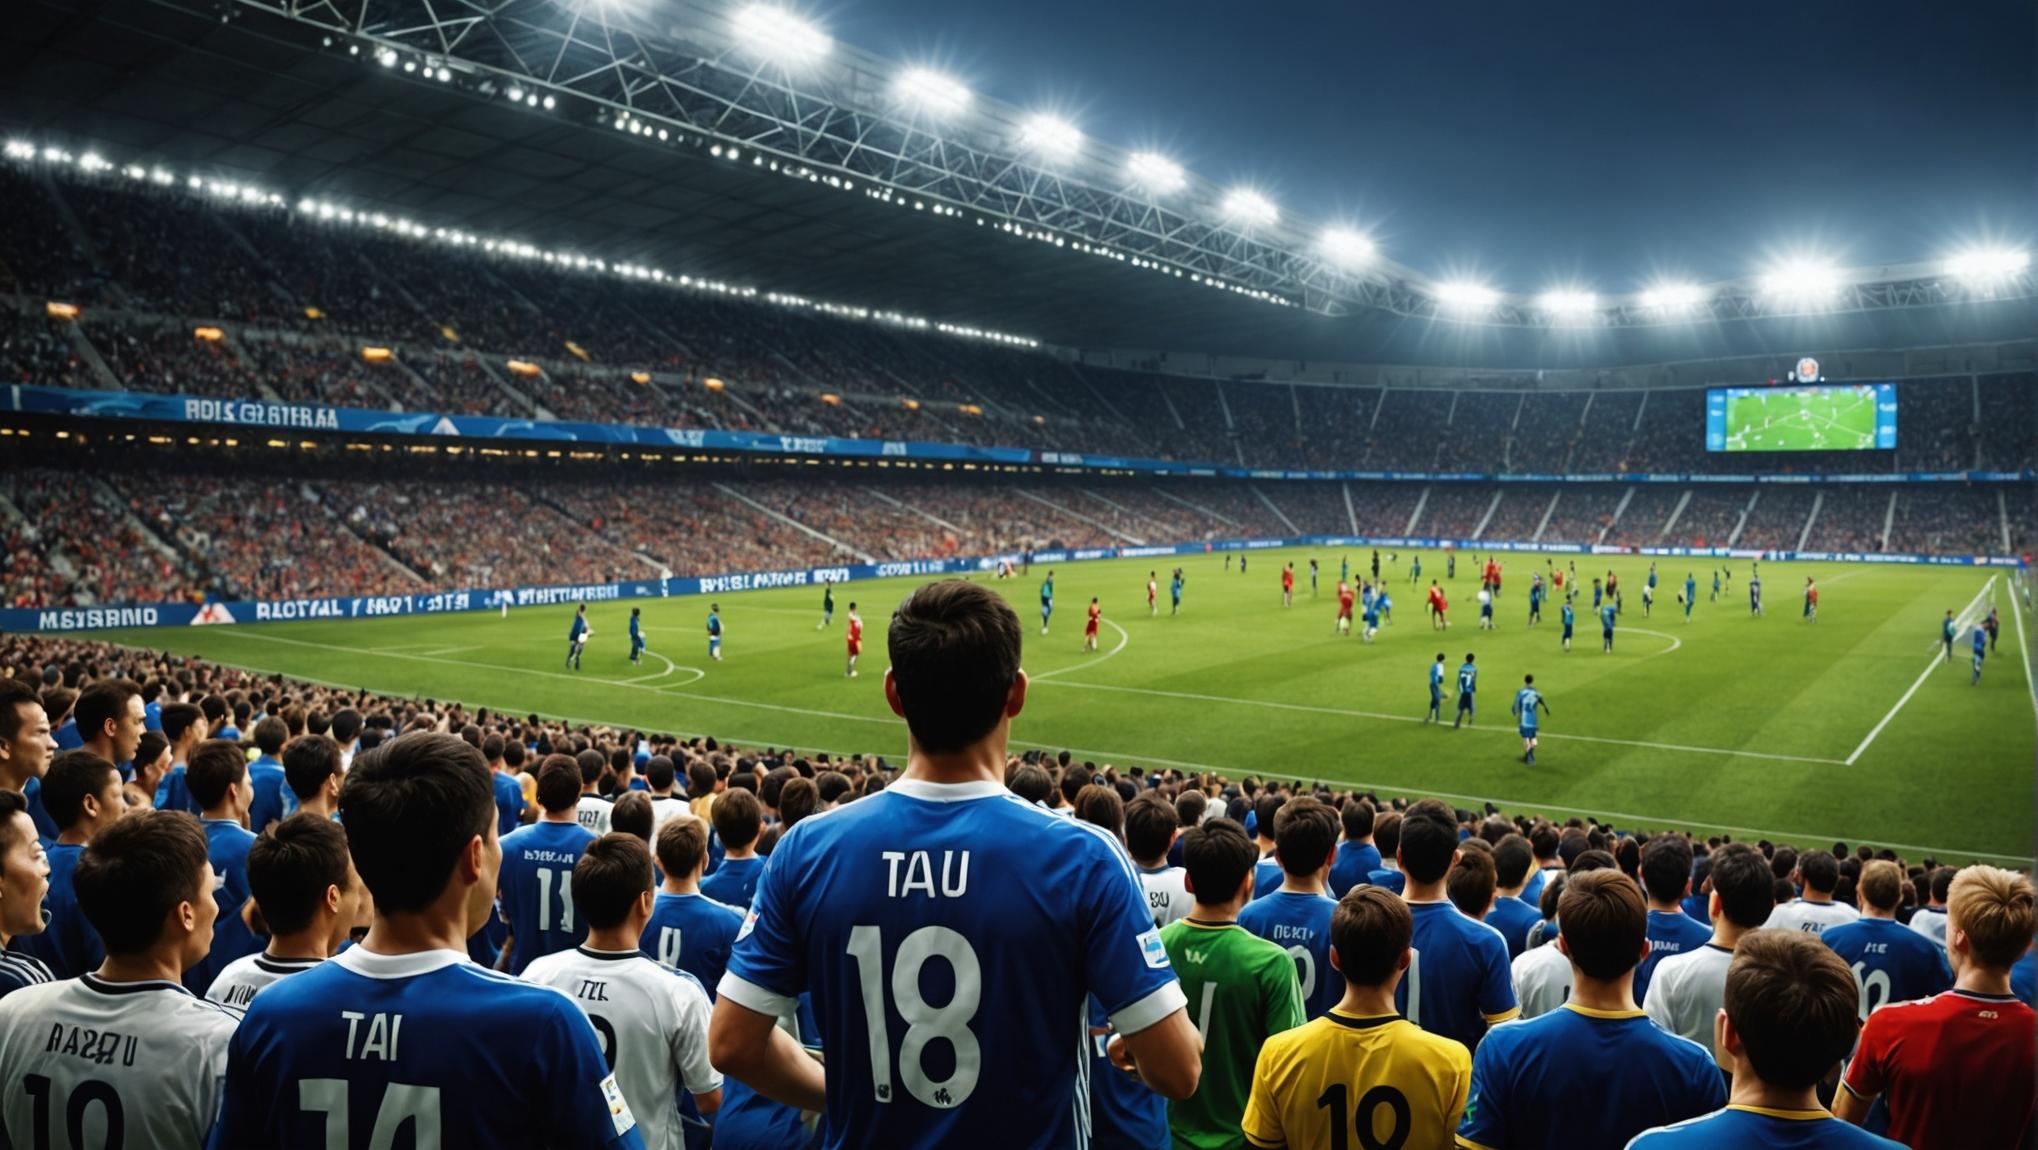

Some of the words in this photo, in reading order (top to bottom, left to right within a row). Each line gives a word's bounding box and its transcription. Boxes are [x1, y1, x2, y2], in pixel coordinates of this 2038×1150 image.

[882, 850, 970, 899] TAU
[341, 1010, 403, 1062] TAI
[846, 925, 982, 1109] 18
